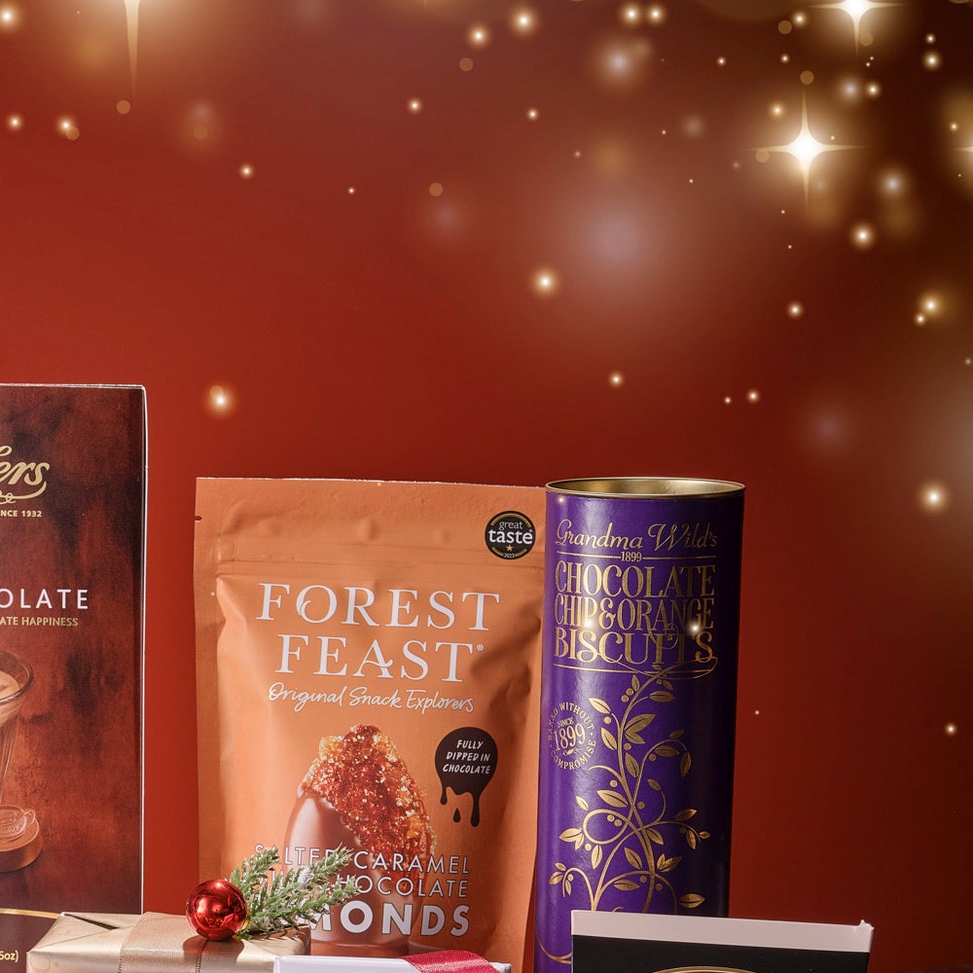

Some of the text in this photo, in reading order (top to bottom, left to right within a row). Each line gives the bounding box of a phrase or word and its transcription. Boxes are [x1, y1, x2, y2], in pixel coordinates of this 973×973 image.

[22, 510, 42, 518] 1932
[499, 521, 523, 530] great
[488, 529, 533, 545] taste
[555, 519, 718, 551] Grandma Wild's
[621, 551, 642, 562] 1899
[555, 560, 716, 598] CHOCOLATE
[255, 582, 500, 631] FOREST
[21, 616, 79, 627] HAPPINESS
[268, 682, 474, 714] Original Snack Explorers
[457, 740, 483, 749] FULLY
[554, 723, 586, 751] 1899
[446, 751, 491, 761] DIPPED IN
[442, 764, 491, 774] CHOCOLATE
[354, 850, 470, 875] CARAMEL
[324, 874, 468, 898] HOCOLATE
